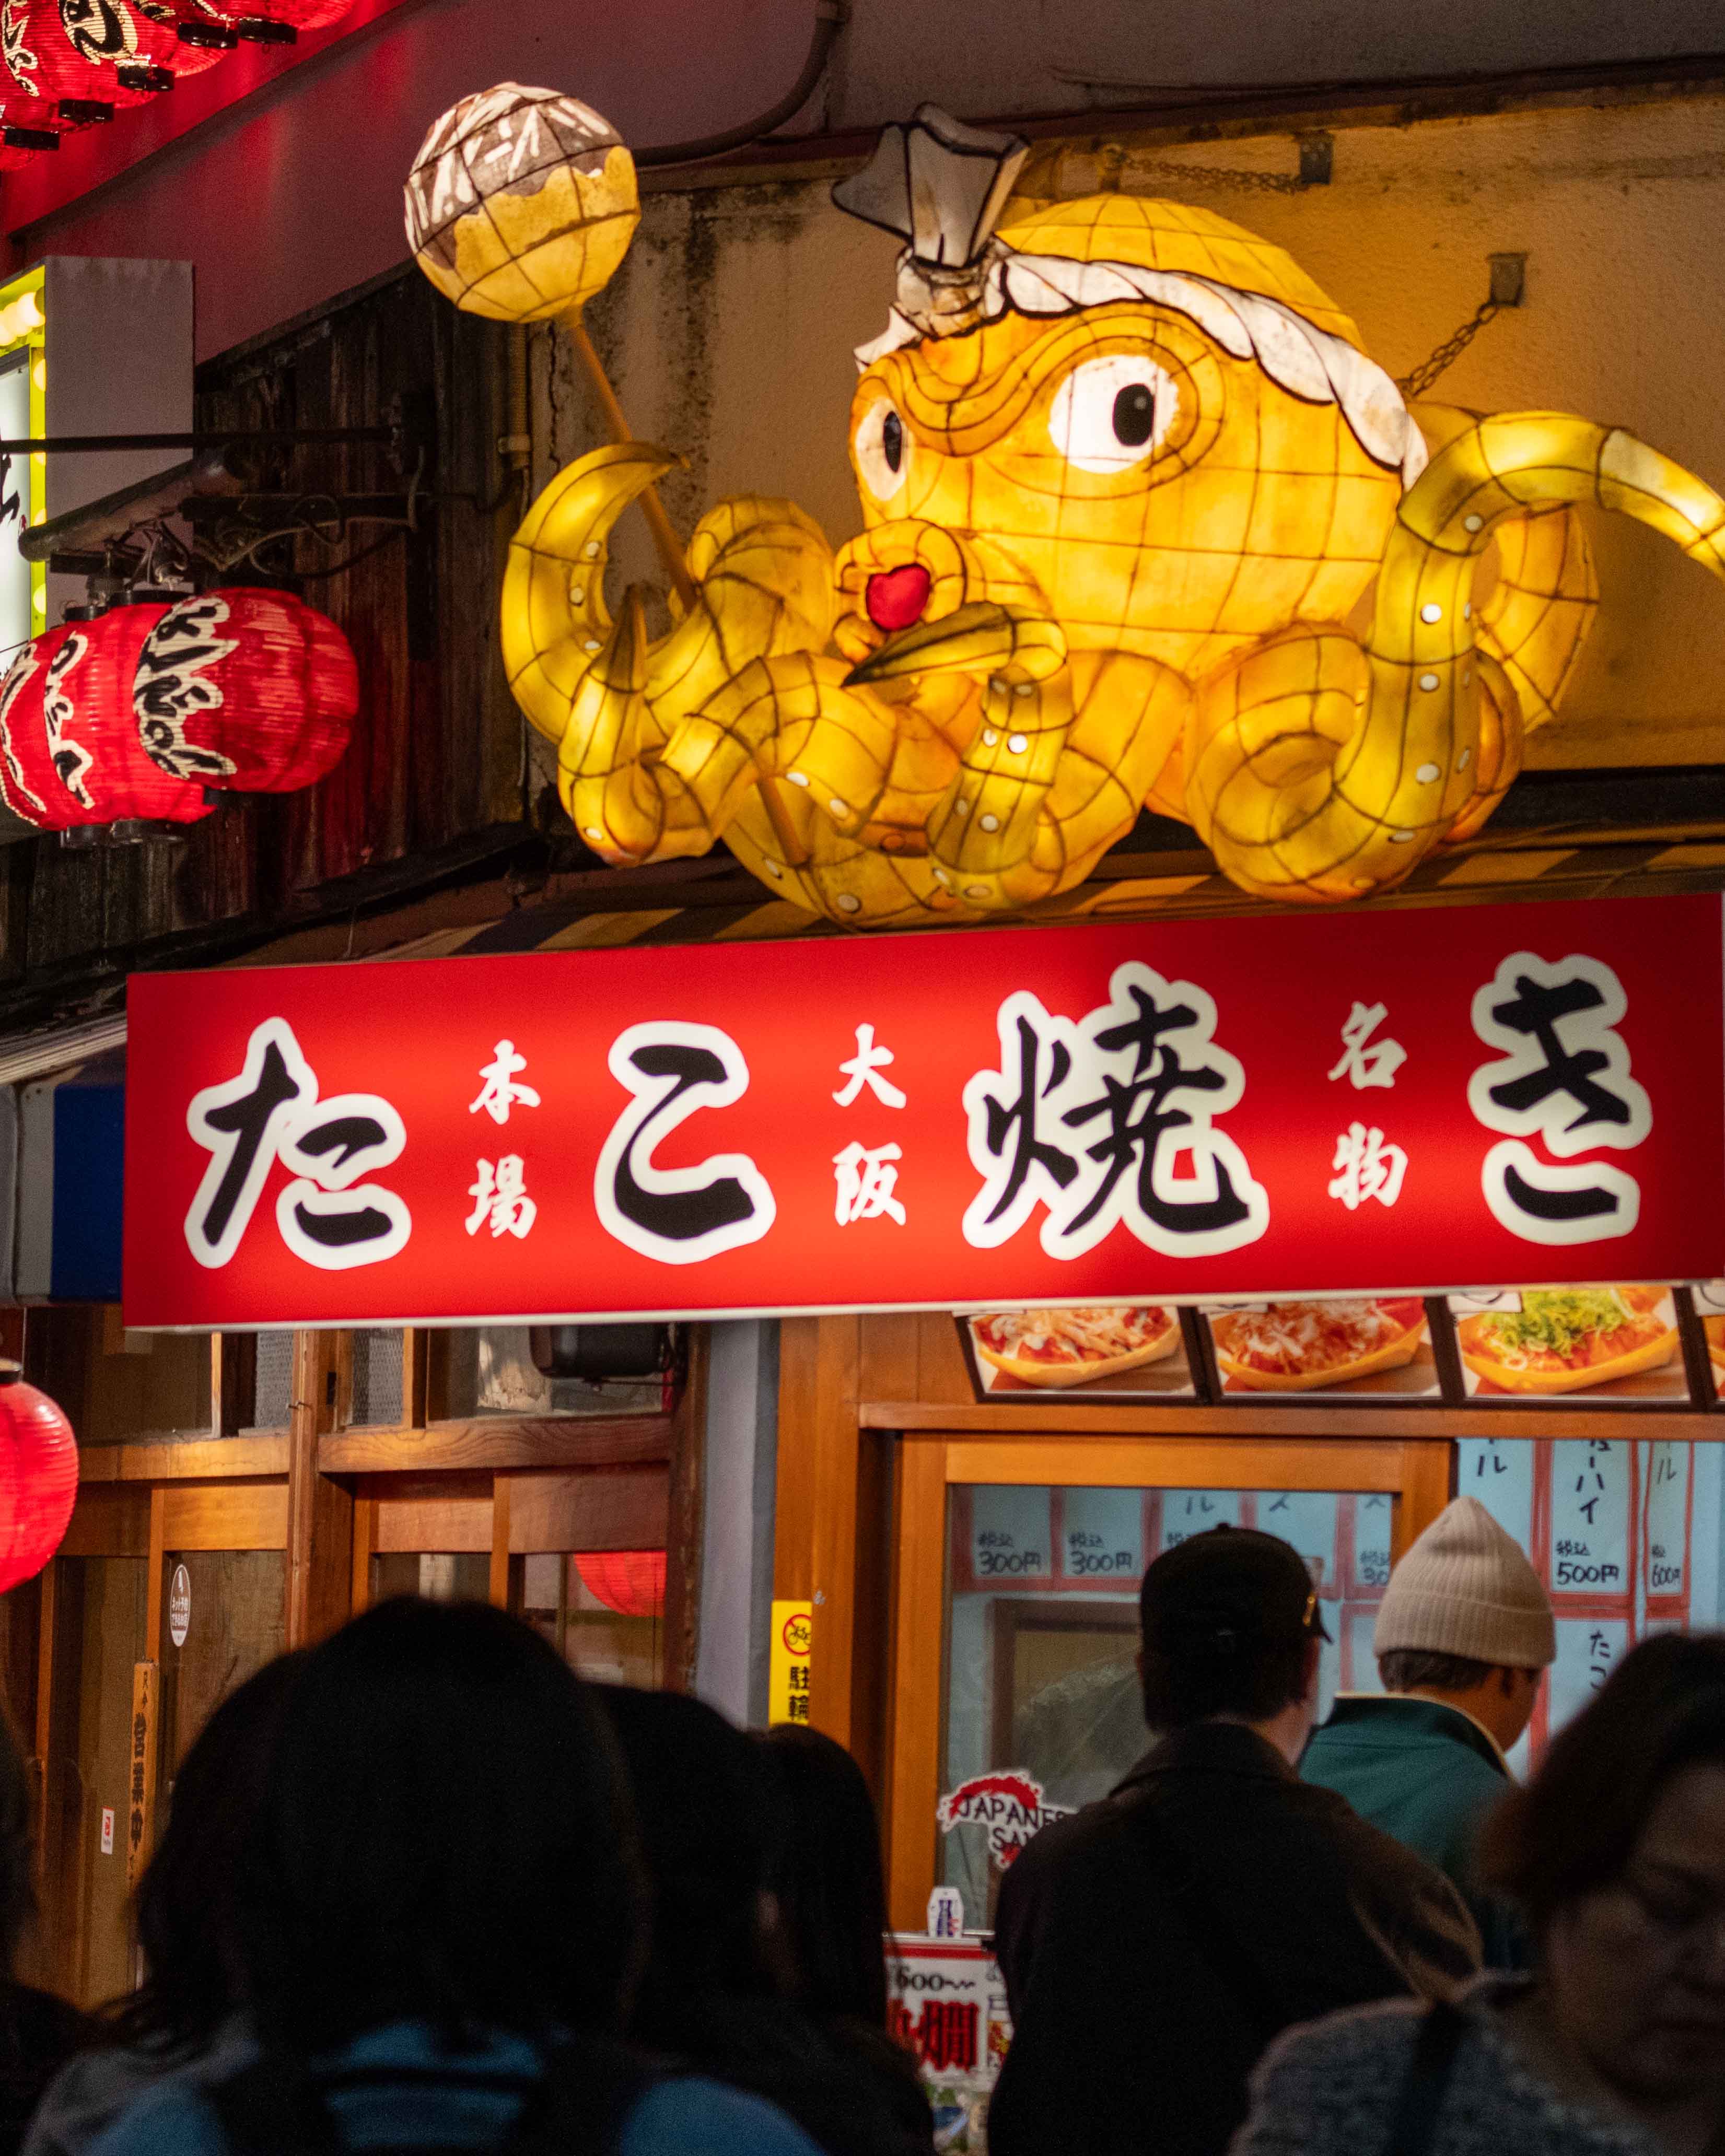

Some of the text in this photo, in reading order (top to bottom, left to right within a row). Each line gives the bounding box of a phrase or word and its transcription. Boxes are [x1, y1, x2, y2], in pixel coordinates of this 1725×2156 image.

[465, 1039, 541, 1239] 本場
[832, 1023, 906, 1226] 大阪
[1328, 1003, 1408, 1210] 名物
[978, 1550, 1042, 1575] 300円
[1069, 1550, 1133, 1575] 300円
[1556, 1562, 1619, 1586] 500円
